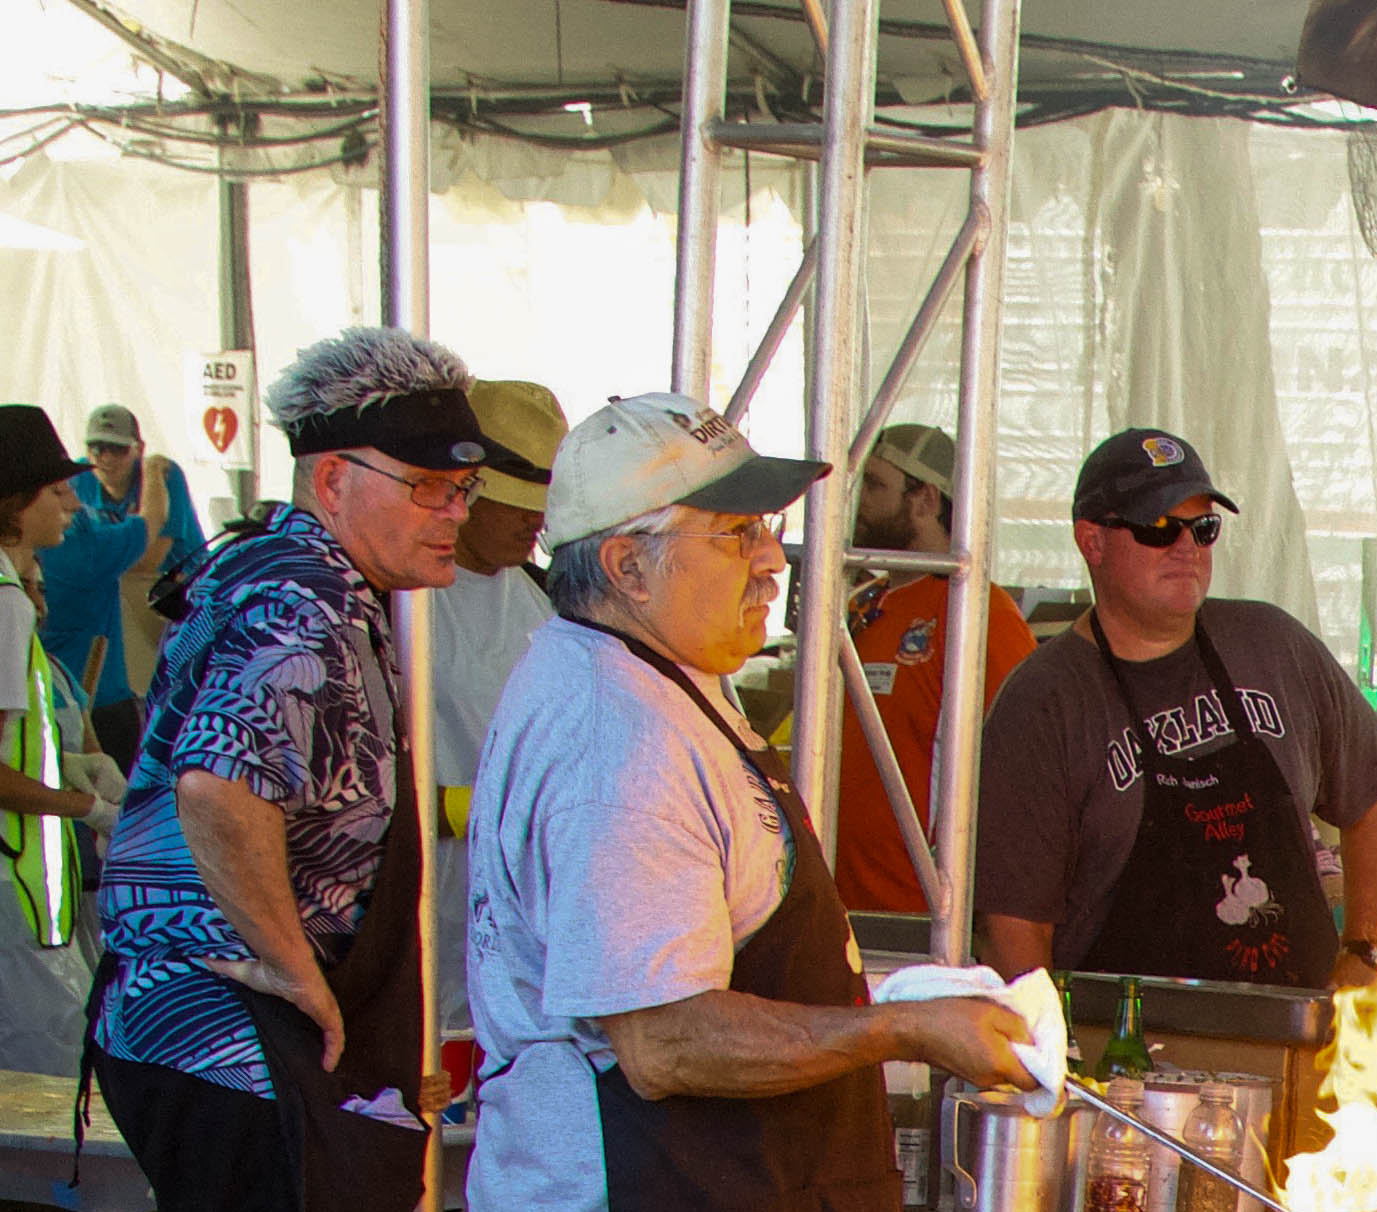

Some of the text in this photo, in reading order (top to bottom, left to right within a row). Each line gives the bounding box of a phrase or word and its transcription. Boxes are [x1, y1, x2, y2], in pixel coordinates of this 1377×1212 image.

[203, 362, 237, 380] AED
[1107, 685, 1285, 792] OAKLAD
[1184, 792, 1255, 822] Gourmet
[1204, 822, 1245, 841] Alley
